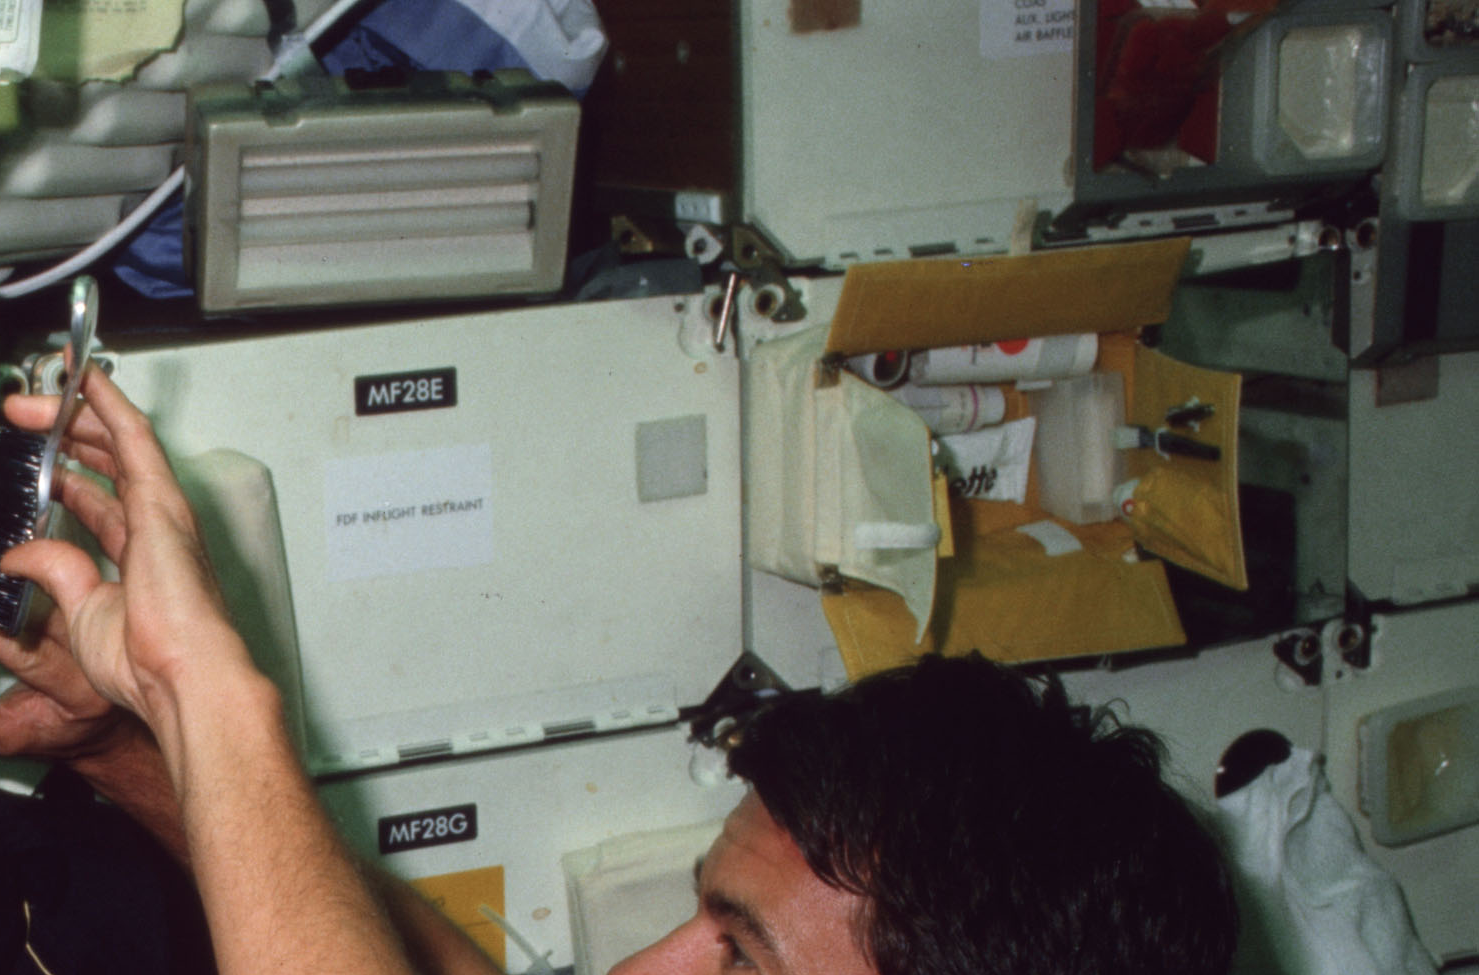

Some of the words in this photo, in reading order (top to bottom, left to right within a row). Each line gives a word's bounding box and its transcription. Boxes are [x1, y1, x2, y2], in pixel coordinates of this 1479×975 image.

[368, 378, 443, 406] MF28E
[336, 513, 358, 526] FDF
[362, 506, 415, 523] INFLIGHT
[421, 498, 483, 516] RESTRAINT
[389, 813, 468, 844] MF28G
